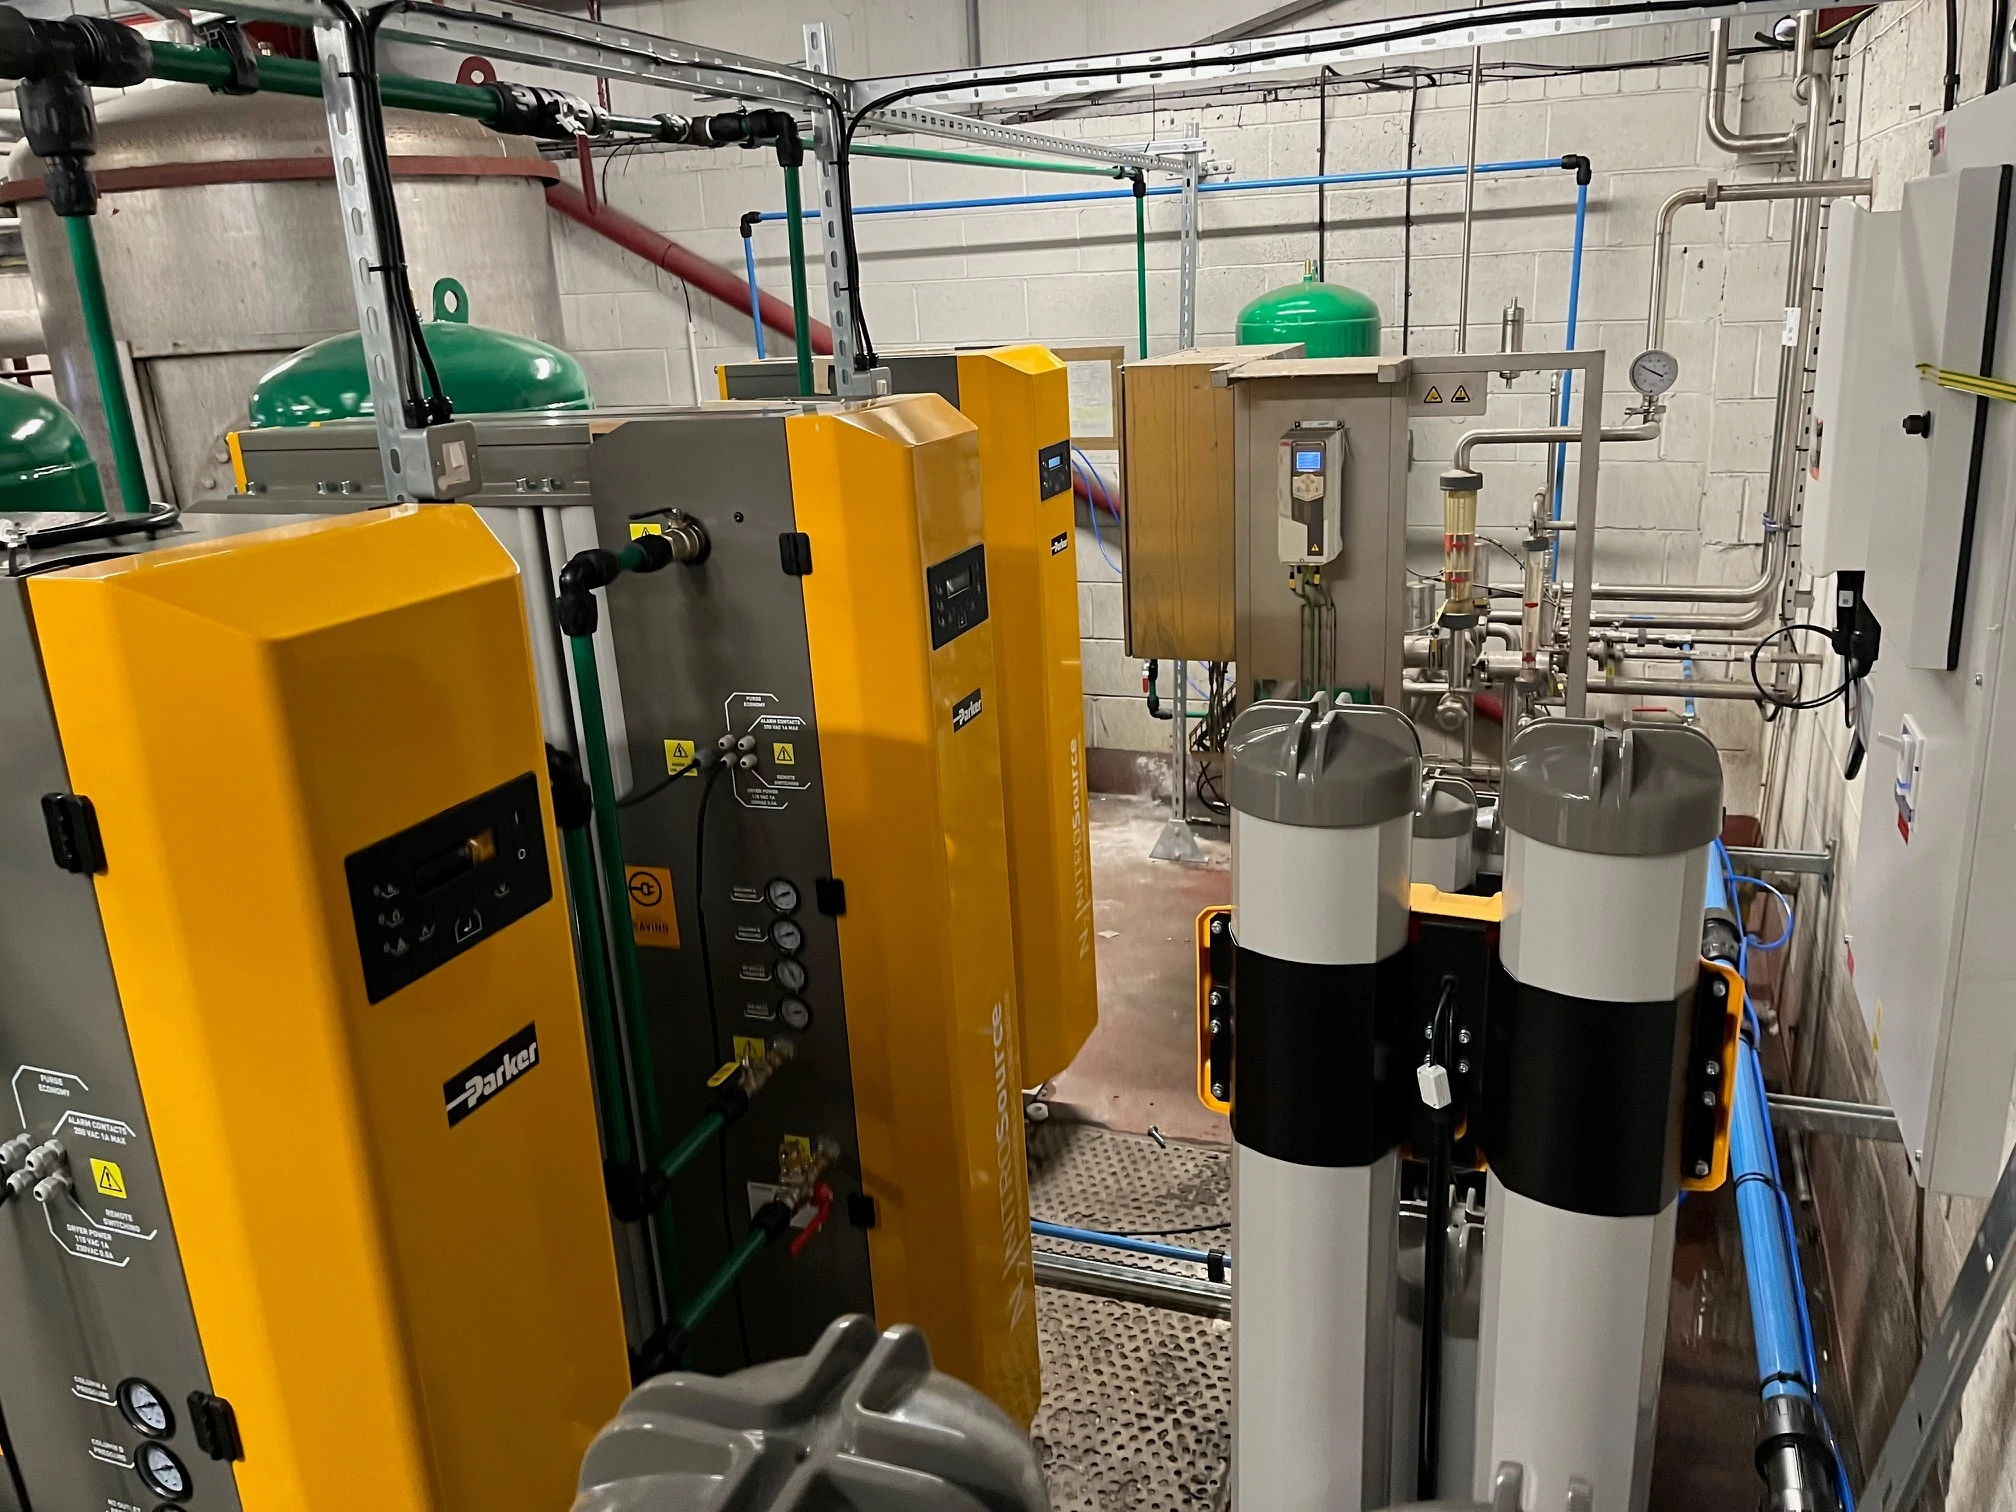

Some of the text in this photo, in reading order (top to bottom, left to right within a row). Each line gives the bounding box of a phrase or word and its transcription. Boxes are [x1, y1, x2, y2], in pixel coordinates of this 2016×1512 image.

[1052, 539, 1068, 552] Parker
[953, 700, 981, 725] Parker
[447, 1042, 537, 1109] Parker
[38, 1083, 70, 1097] ECONOMY
[68, 1116, 127, 1136] ALARM CONTACTS
[86, 1129, 100, 1140] VAC
[100, 1132, 110, 1142] 1A
[110, 1134, 127, 1146] MAX
[105, 1208, 134, 1222] REMOTE
[103, 1217, 140, 1233] SWITCHING
[88, 1228, 113, 1242] POWER
[86, 1237, 100, 1248] VAC
[100, 1240, 110, 1250] 1A
